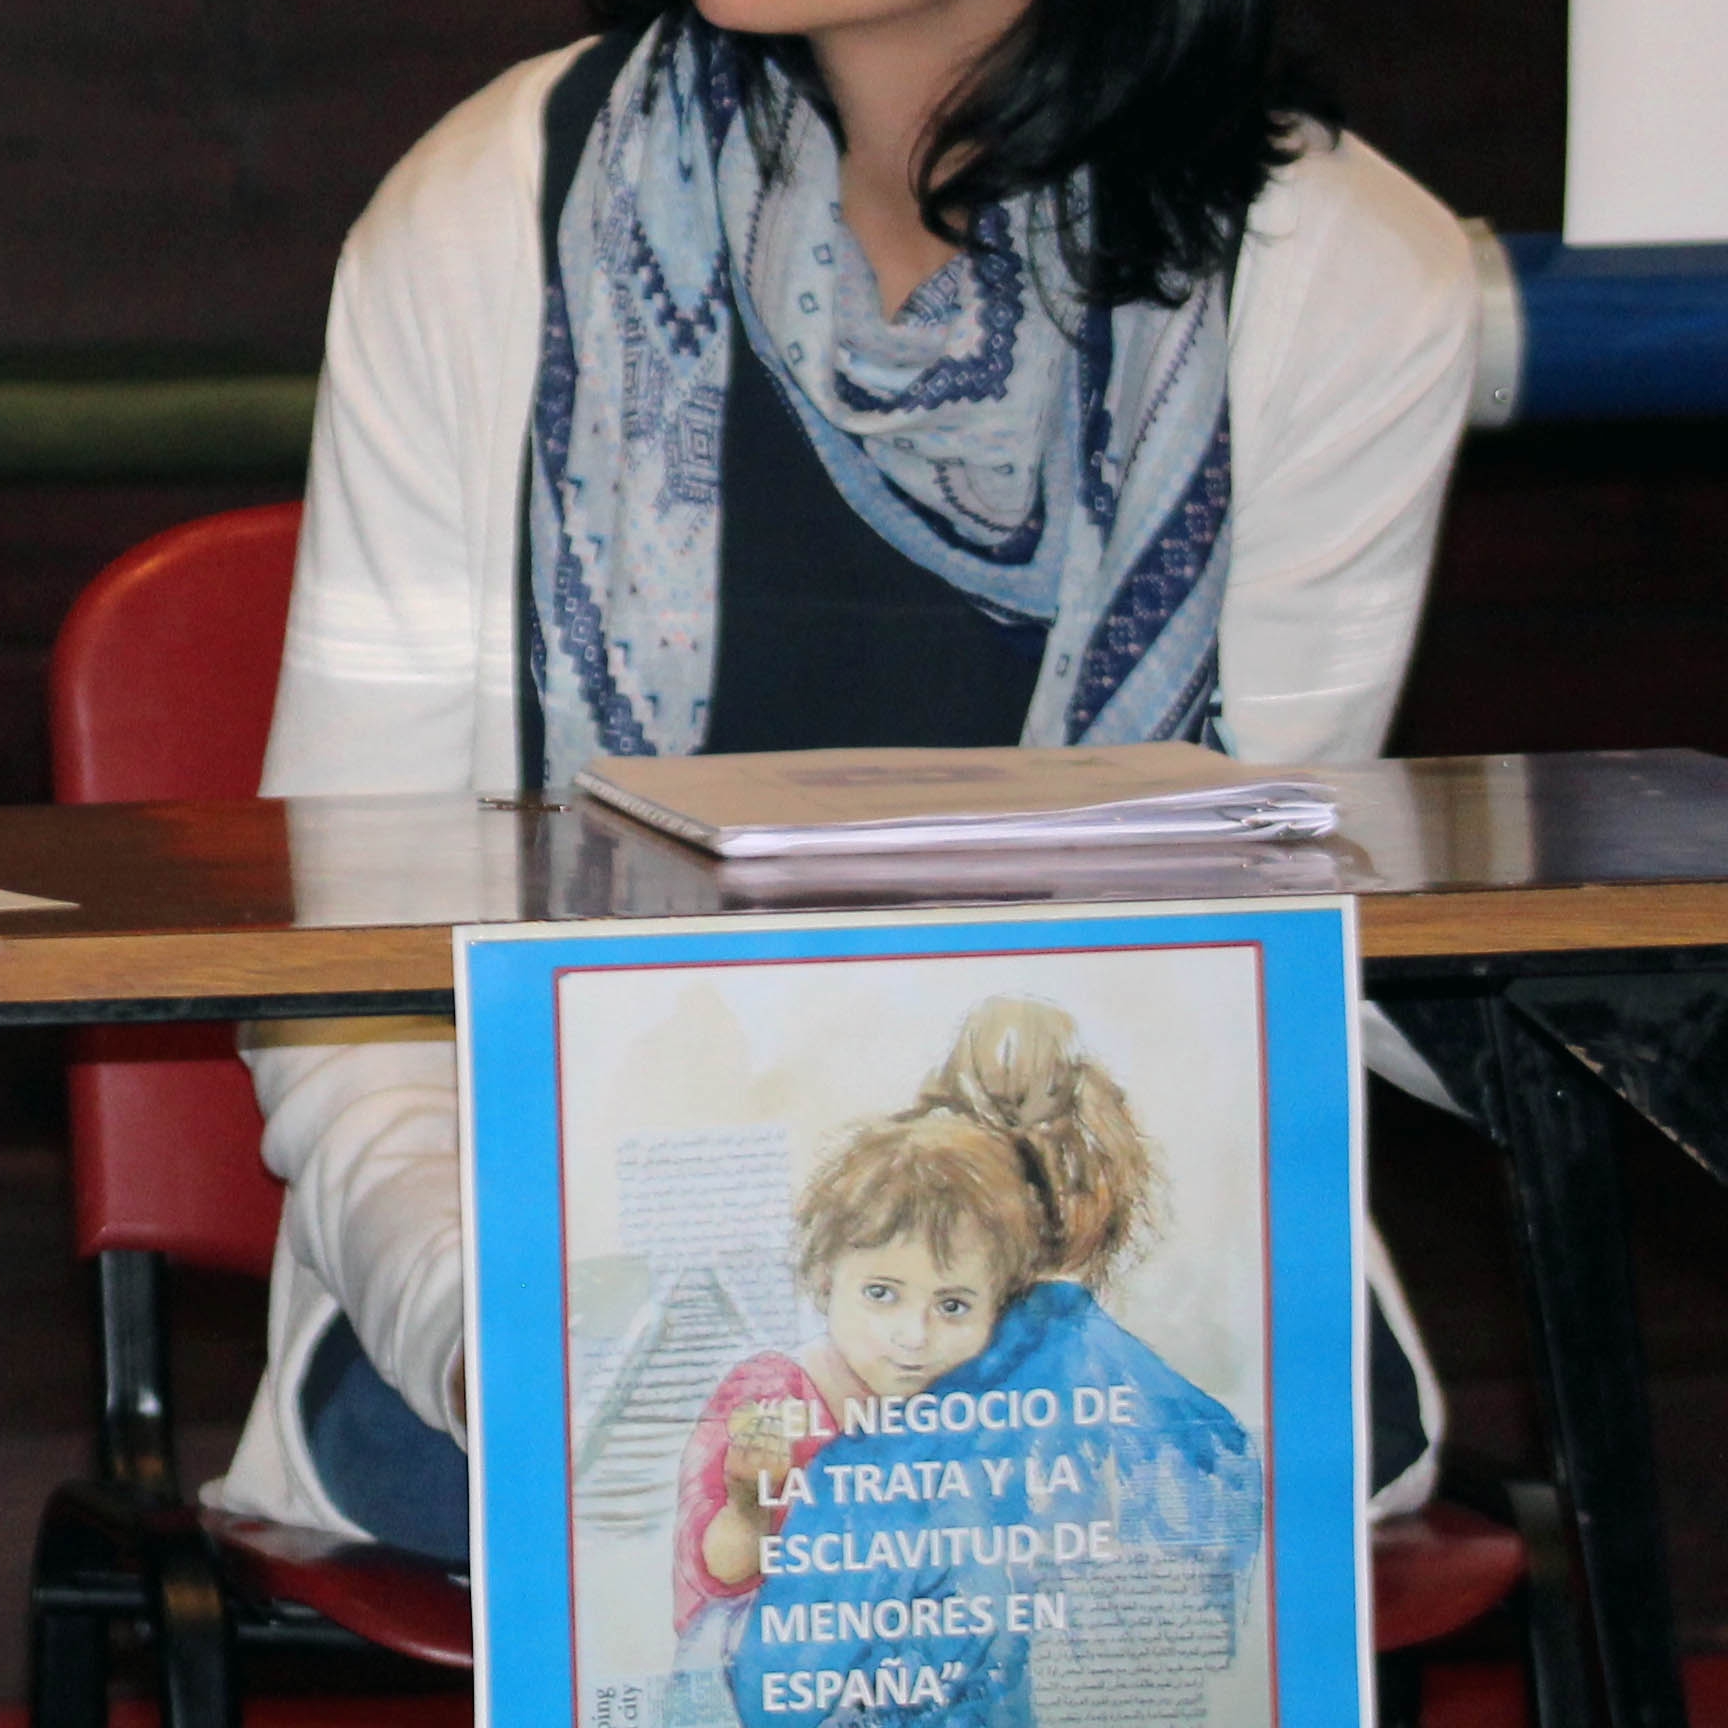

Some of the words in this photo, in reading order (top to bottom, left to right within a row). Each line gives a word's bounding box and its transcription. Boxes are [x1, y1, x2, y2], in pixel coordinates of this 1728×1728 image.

[846, 1389, 1058, 1436] NEGOCIO
[1073, 1387, 1134, 1425] DE
[758, 1469, 815, 1507] LA
[824, 1461, 971, 1504] TRATA
[983, 1458, 1011, 1497] Y
[1025, 1454, 1082, 1494] LA
[759, 1526, 1042, 1574] ESCLAVITUD
[1054, 1522, 1114, 1563] DE
[761, 1597, 994, 1644] MENORES
[1007, 1592, 1067, 1633] EN
[618, 1684, 643, 1720] city
